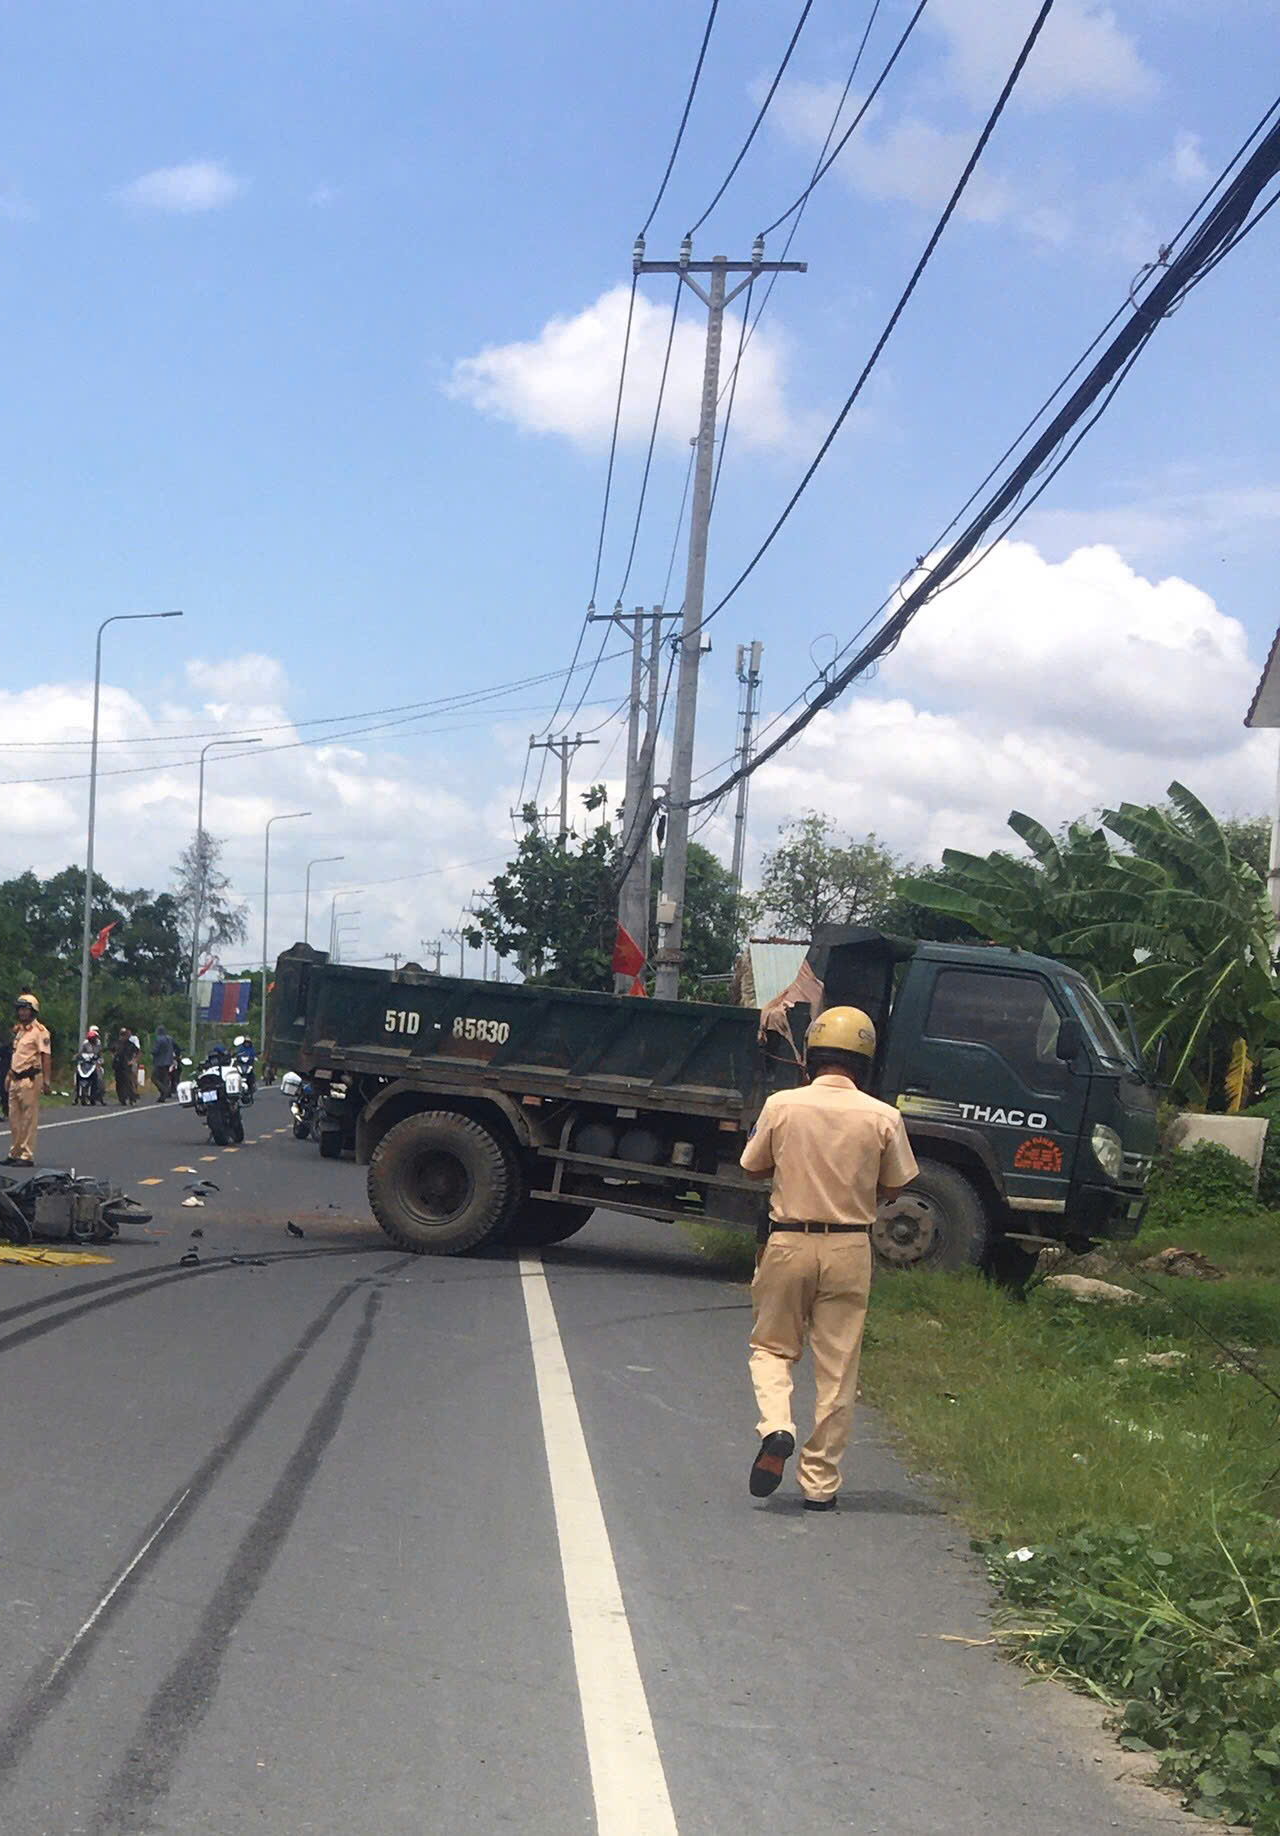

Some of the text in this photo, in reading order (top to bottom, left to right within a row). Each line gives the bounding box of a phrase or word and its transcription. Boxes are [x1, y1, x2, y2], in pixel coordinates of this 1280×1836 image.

[384, 1009, 420, 1035] 51D
[452, 1016, 511, 1045] 85830
[958, 1103, 1048, 1129] THACO
